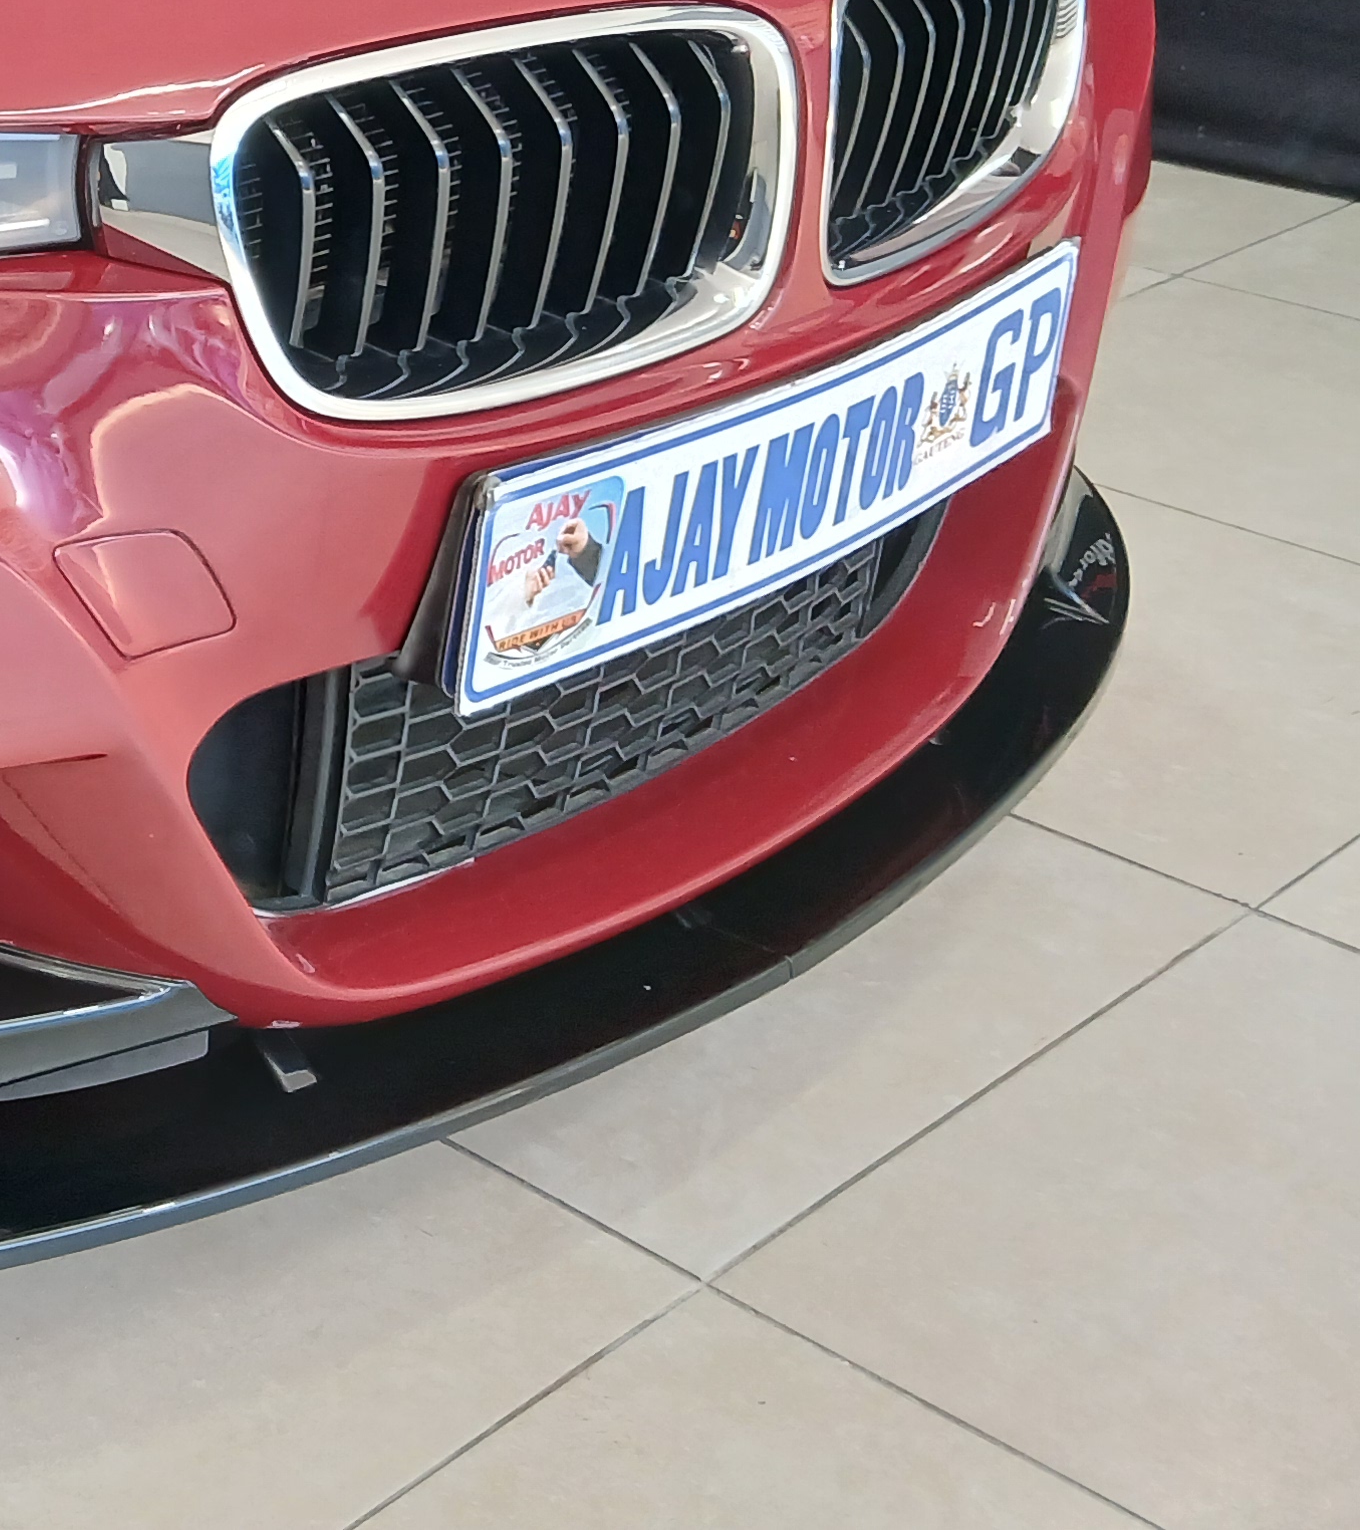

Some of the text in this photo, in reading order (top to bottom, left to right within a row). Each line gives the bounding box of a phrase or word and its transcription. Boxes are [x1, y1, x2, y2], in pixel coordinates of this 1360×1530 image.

[596, 286, 1062, 626] AJAY MOTOR GP
[526, 488, 593, 532] AJAY
[486, 537, 546, 588] MOTOR
